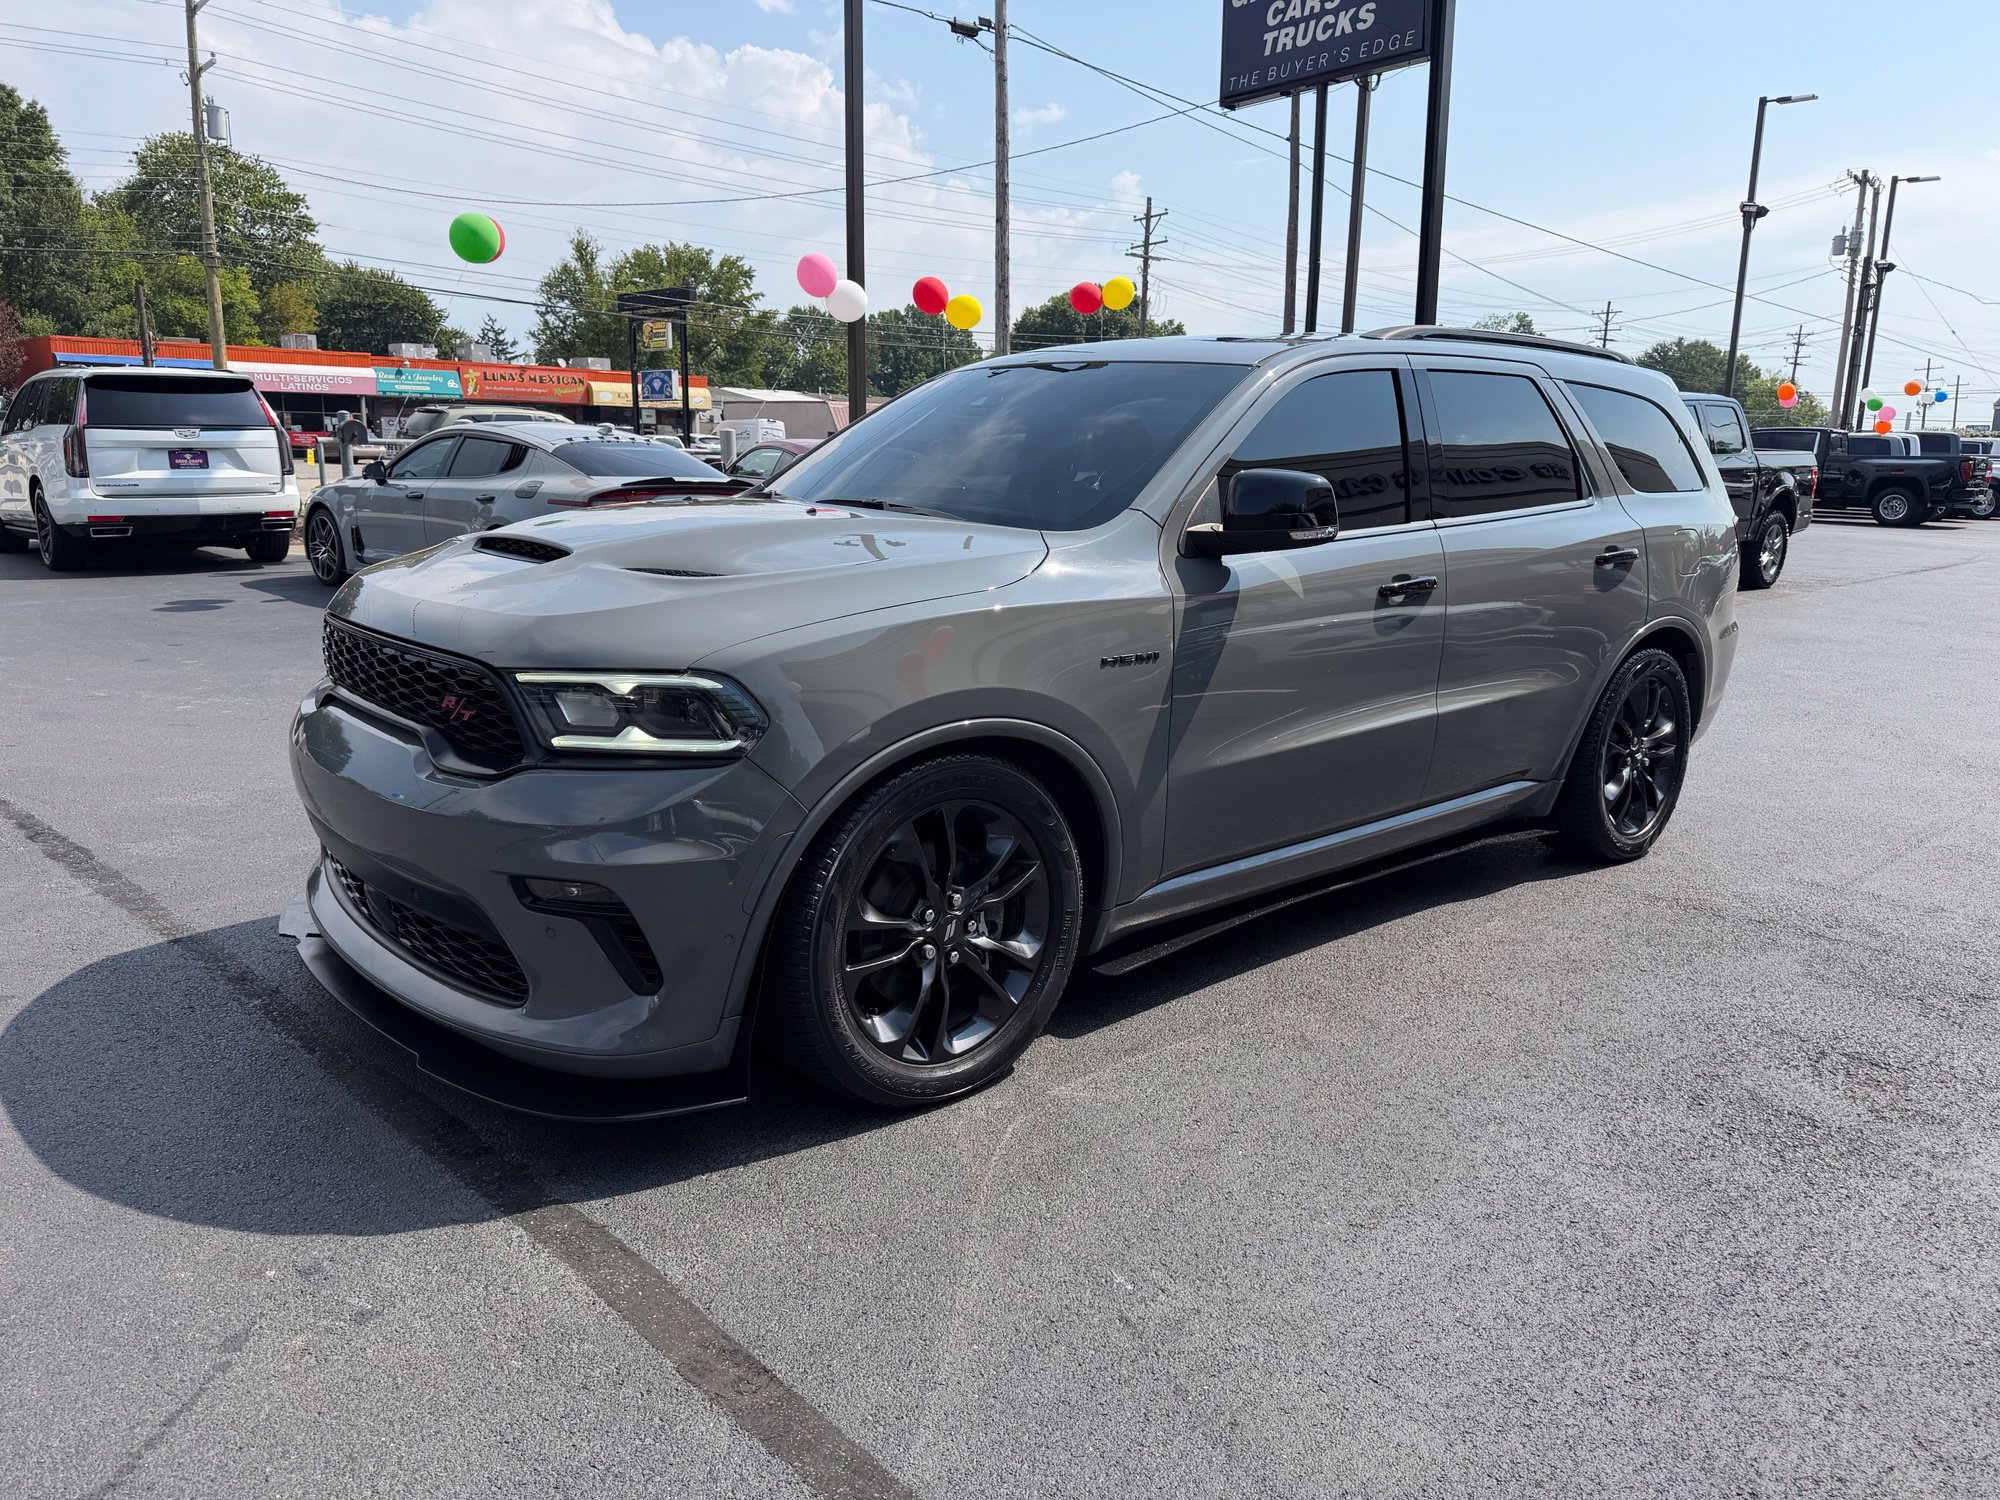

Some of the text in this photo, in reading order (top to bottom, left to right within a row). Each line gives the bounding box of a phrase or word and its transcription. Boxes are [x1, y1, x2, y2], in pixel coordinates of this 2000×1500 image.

[1262, 2, 1377, 57] TRUCKS
[1229, 30, 1416, 91] THE BUYER'S EDGE
[254, 373, 353, 385] MULTI-SERVICIOS
[280, 382, 329, 391] LATINOS
[483, 371, 585, 386] LUNA'S MEXICAN
[1100, 651, 1160, 668] HEMI
[441, 695, 476, 721] R/T
